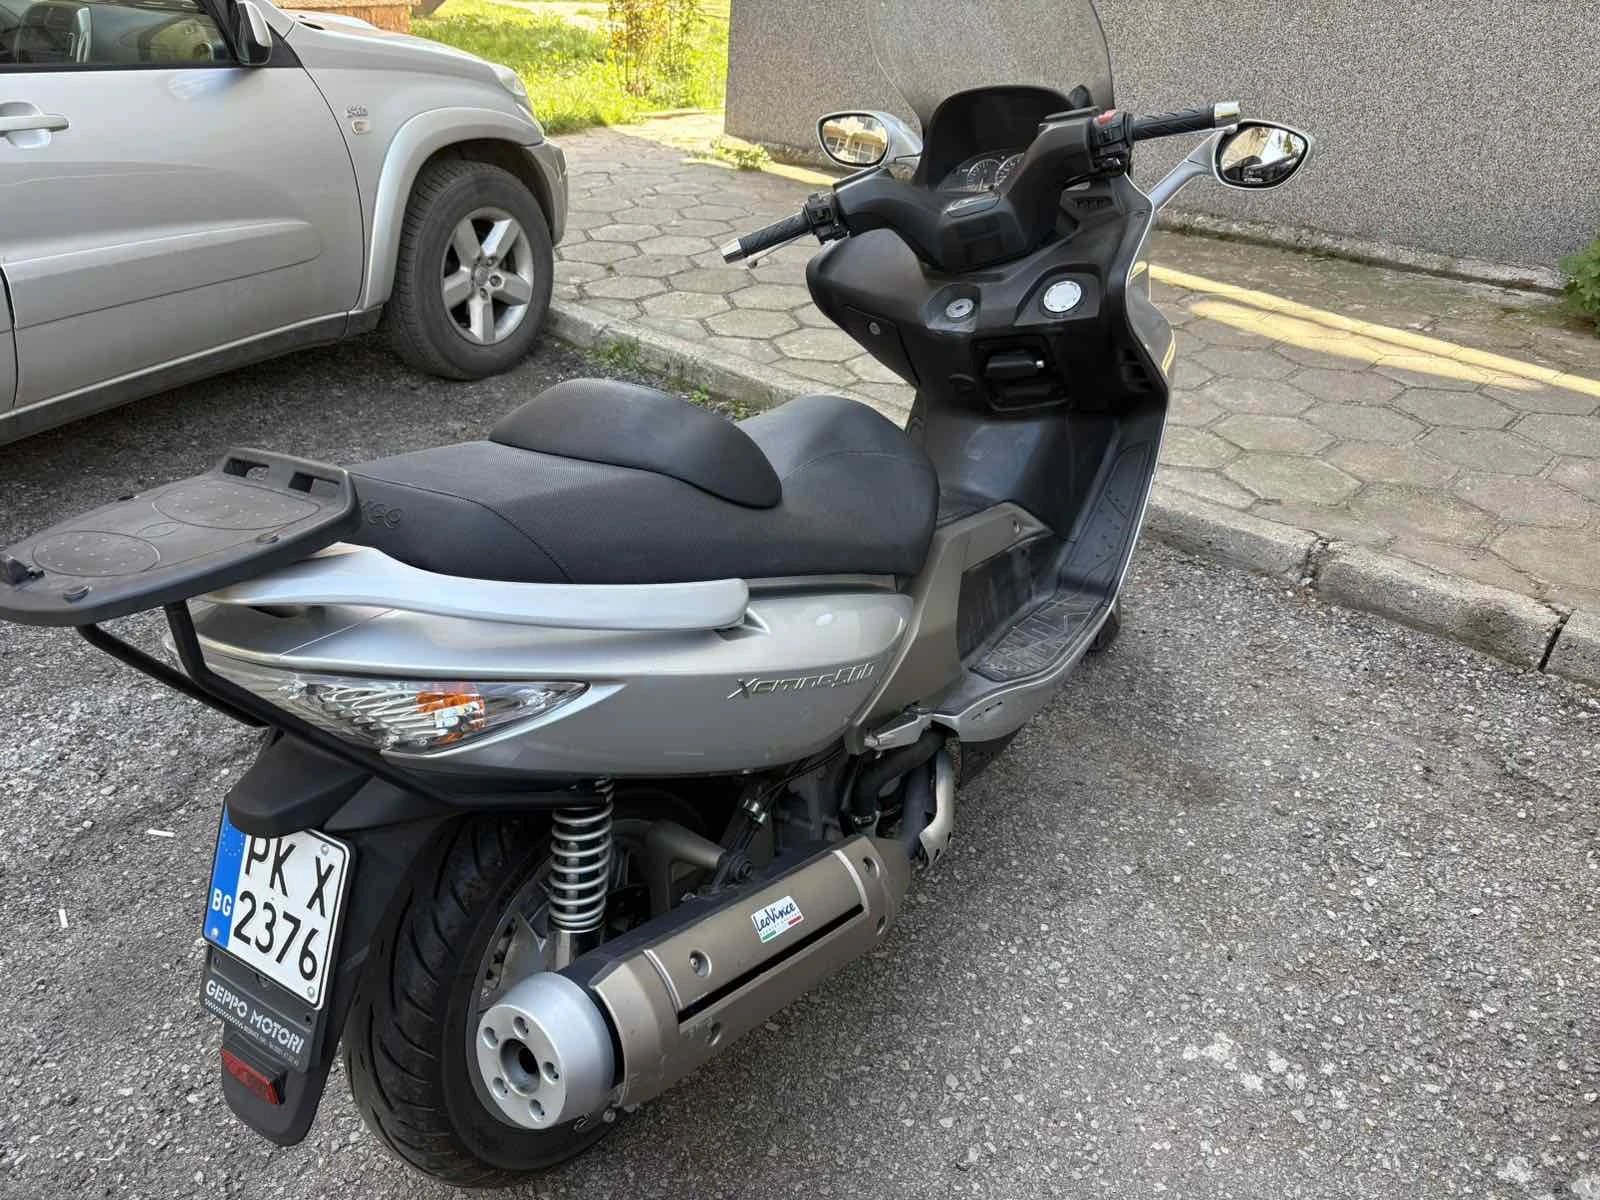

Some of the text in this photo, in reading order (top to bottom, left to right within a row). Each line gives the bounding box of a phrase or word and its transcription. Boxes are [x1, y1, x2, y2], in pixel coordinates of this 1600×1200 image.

[212, 888, 233, 917] BG
[245, 834, 335, 918] PK X
[233, 890, 319, 982] 2376
[206, 979, 248, 1018] GEPPO
[250, 1008, 305, 1054] MOTORI
